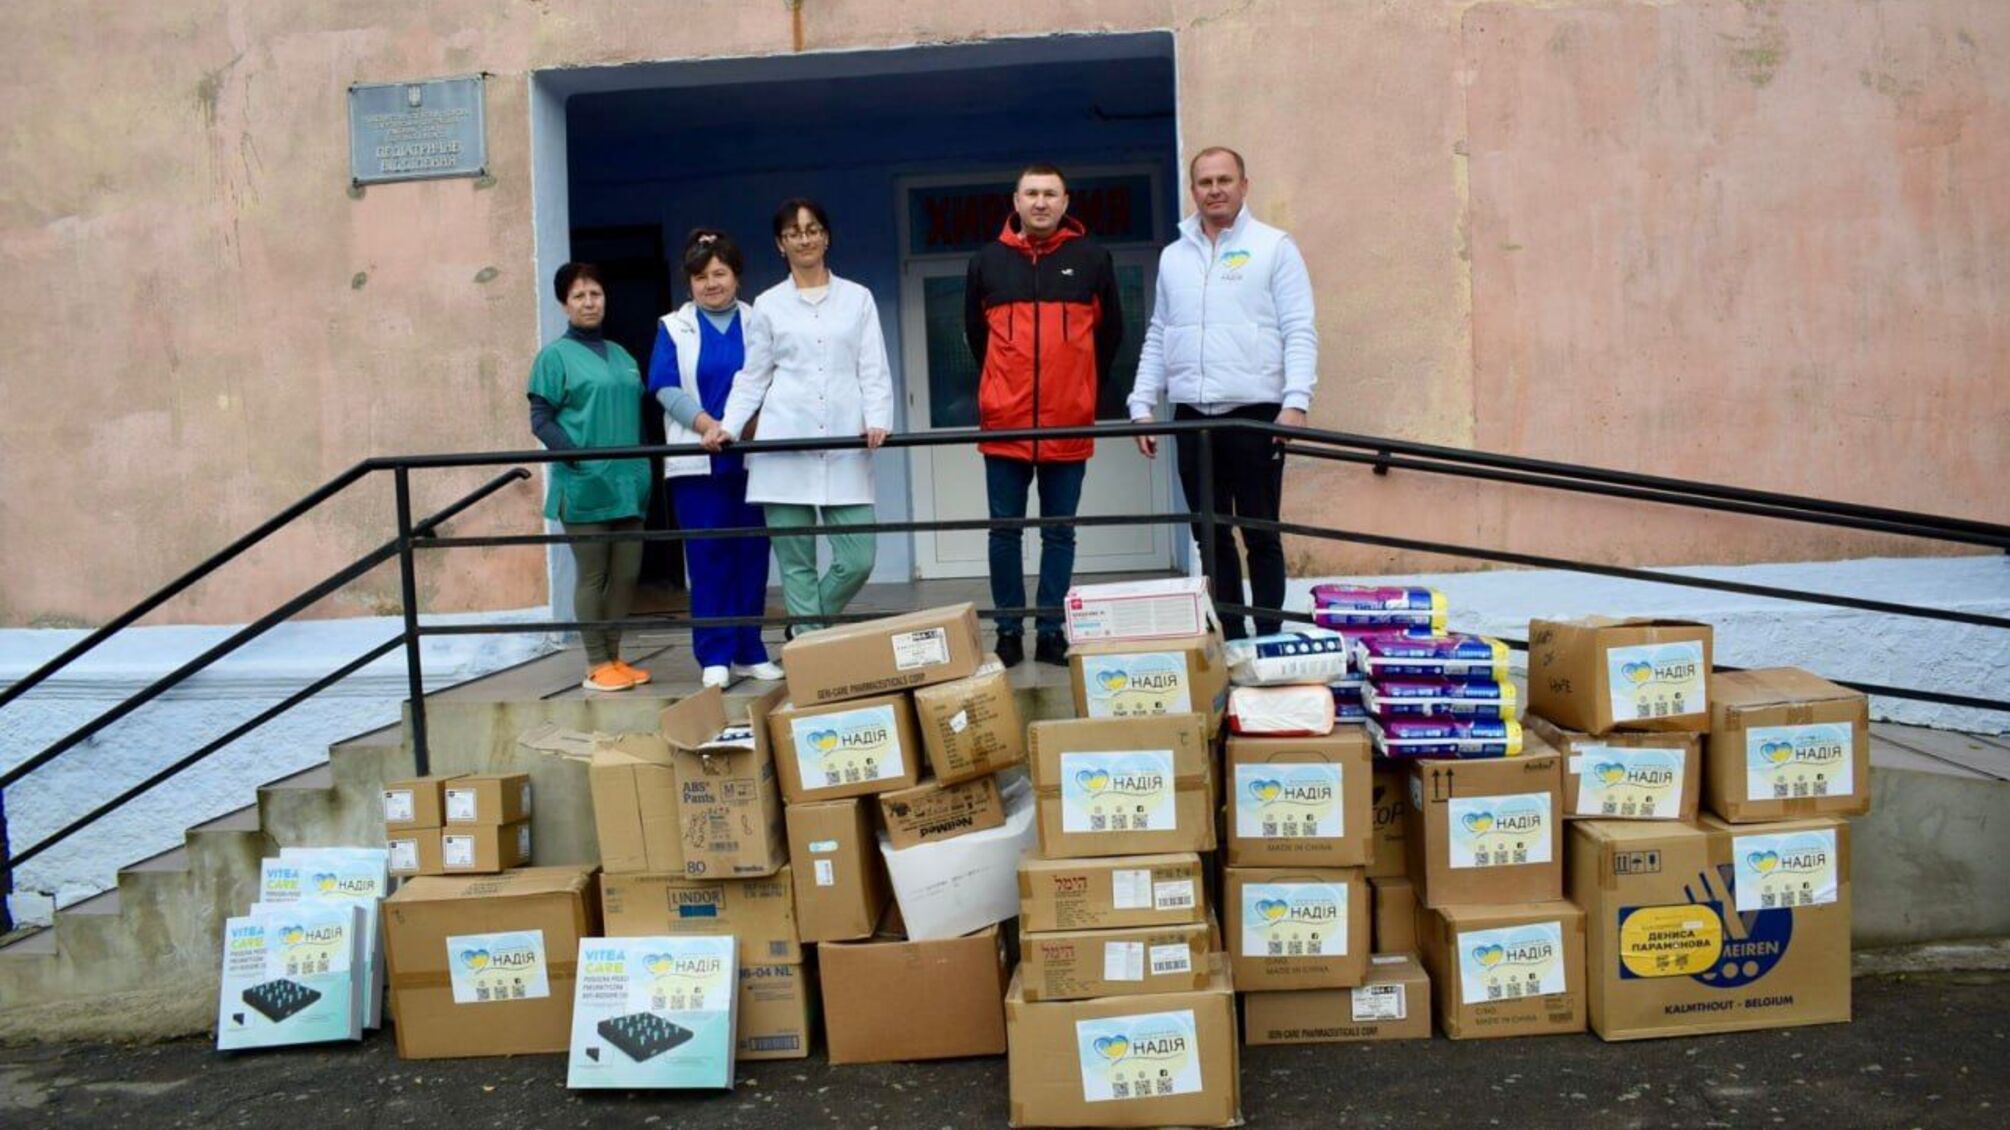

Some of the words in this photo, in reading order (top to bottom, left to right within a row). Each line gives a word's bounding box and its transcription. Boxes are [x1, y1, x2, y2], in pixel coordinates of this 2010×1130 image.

[1655, 665, 1695, 680] НАДІЯ
[1131, 674, 1178, 689] НАДІЯ
[842, 729, 888, 747] НАДІЯ
[1795, 745, 1842, 761] НАДІЯ
[1112, 776, 1163, 792] НАДІЯ
[1628, 769, 1673, 784] НАДІЯ
[683, 792, 716, 804] Pants
[1284, 786, 1332, 801] НАДІЯ
[1496, 815, 1541, 830] НАДІЯ
[687, 860, 706, 874] 80
[1782, 853, 1826, 869] НАДІЯ
[338, 879, 375, 892] НАДІЯ
[672, 890, 721, 904] LINDOR
[1290, 906, 1337, 920] НАДІЯ
[305, 926, 343, 942] НАДІЯ
[1647, 929, 1695, 943] ДЕНИСА
[1506, 944, 1553, 961] НАДІЯ
[1630, 938, 1712, 952] ПАРАМОНОВА
[492, 951, 536, 966] НАДІЯ
[675, 958, 721, 973] НАДІЯ
[1664, 1000, 1734, 1015] KALMTHOUT
[1745, 995, 1793, 1009] BELGIUM
[1132, 1037, 1186, 1055] НАДІЯ
